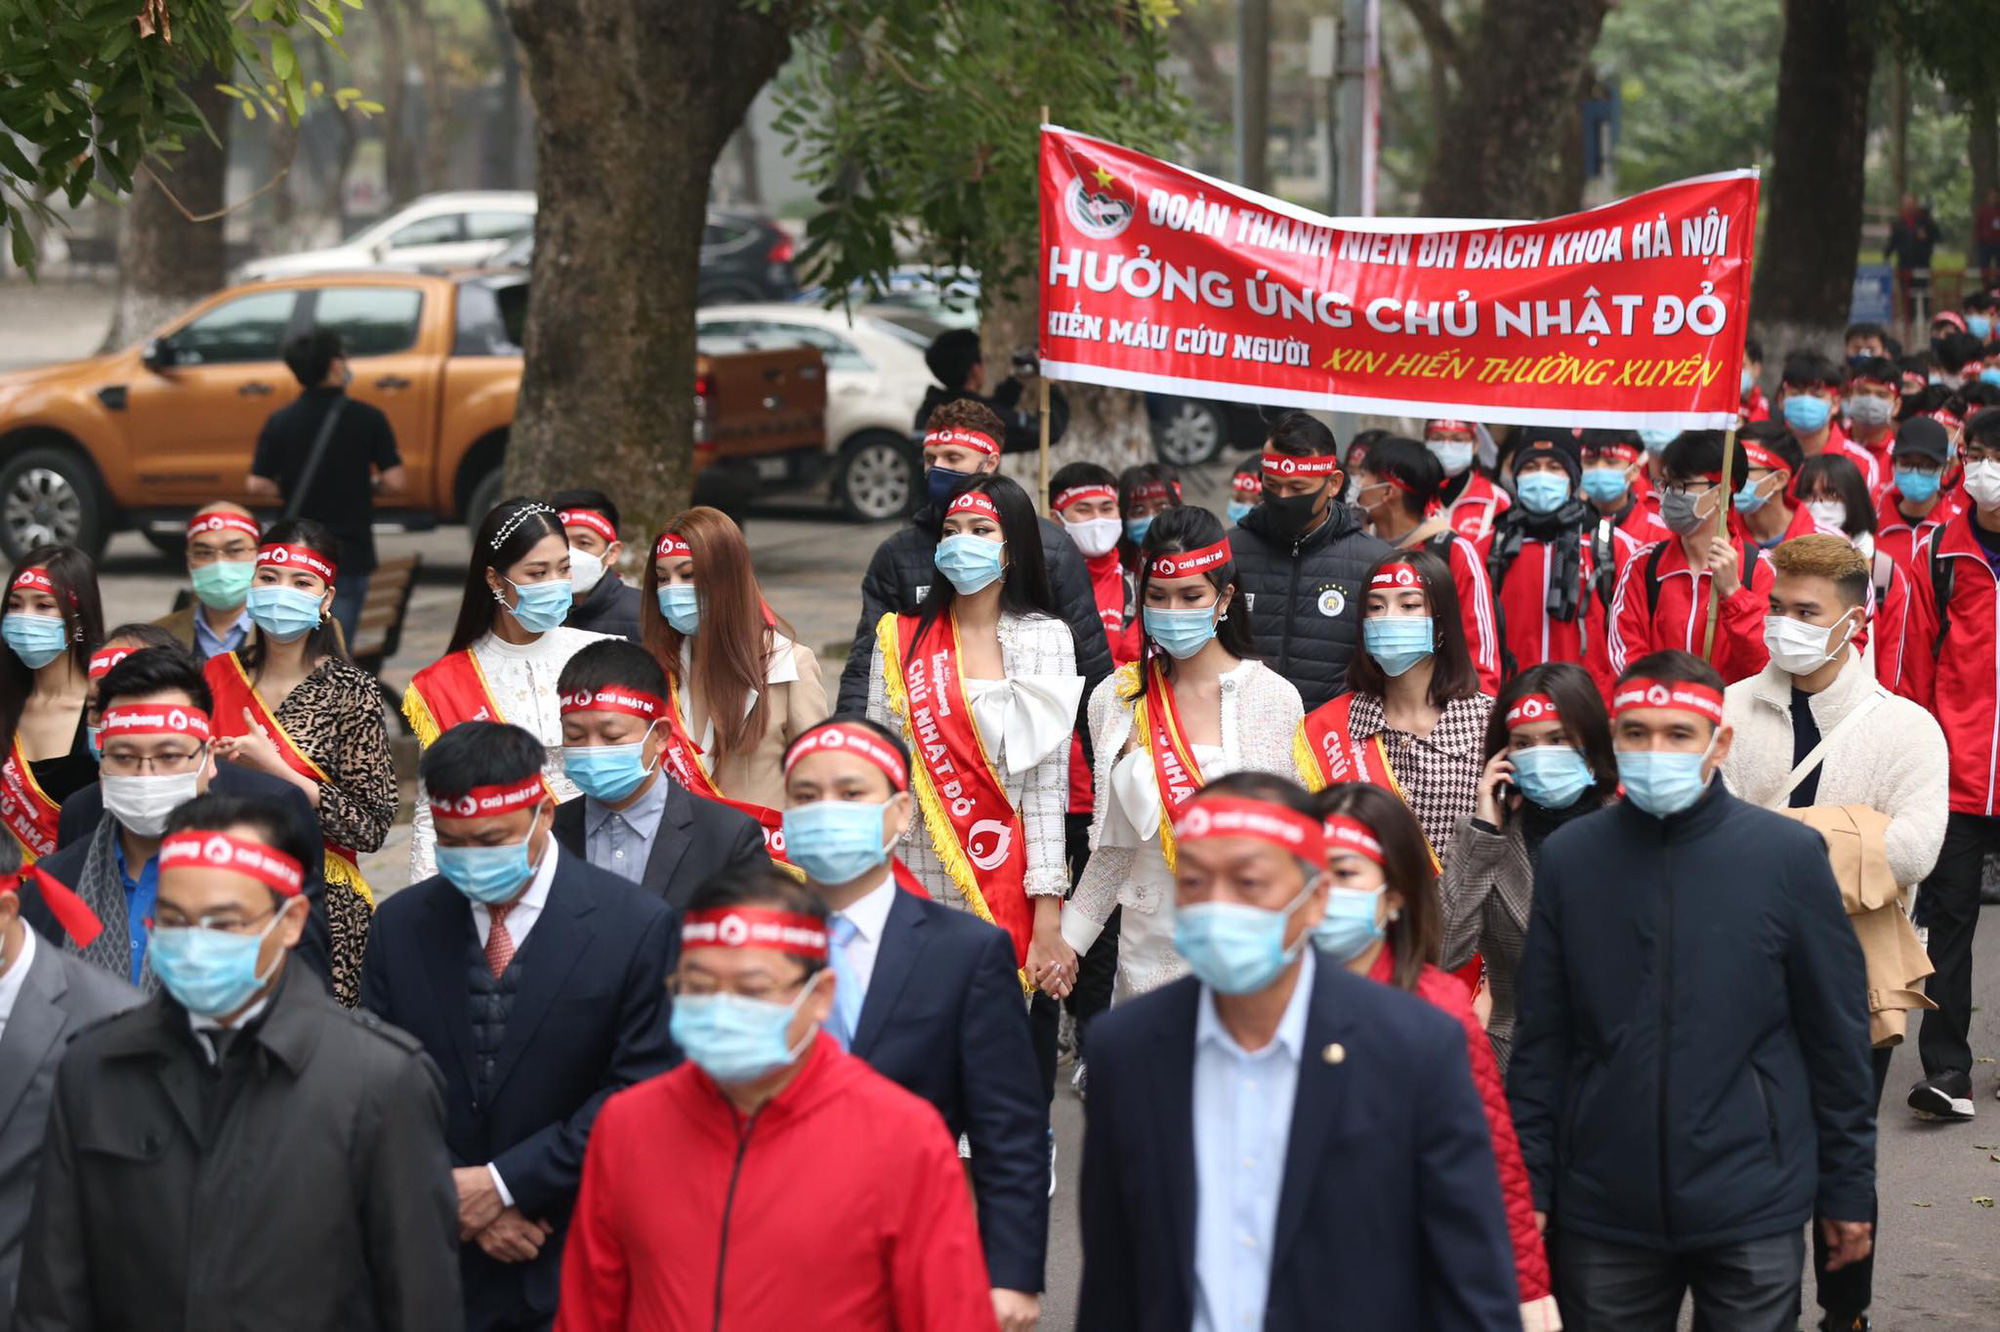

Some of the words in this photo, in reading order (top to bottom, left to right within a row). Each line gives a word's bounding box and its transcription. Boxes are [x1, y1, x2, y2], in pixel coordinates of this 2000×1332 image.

[1148, 188, 1231, 239] ĐOÀN
[1235, 209, 1334, 258] THANH
[1417, 233, 1460, 269] ĐH
[1463, 227, 1546, 270] BÁCH
[1547, 226, 1624, 267] KHOA
[1632, 212, 1673, 261] HÀ
[1681, 207, 1730, 266] NỘI
[1049, 244, 1235, 309] HƯỞNG
[1245, 269, 1354, 329] ỨNG
[1365, 289, 1479, 339] CHỦ
[1494, 284, 1644, 348] NHẬT
[1652, 281, 1728, 337] ĐỎ
[1107, 317, 1170, 350] MÁU
[1174, 323, 1228, 357] CỨU
[1232, 334, 1311, 367] NGƯỜI
[1321, 347, 1388, 374] XIN
[1384, 348, 1475, 380] HIẾN
[1477, 350, 1615, 386] THƯỜNG
[1612, 352, 1723, 387] XUYÊN
[908, 658, 932, 704] CHỦ
[913, 706, 955, 776] NHẬT
[1322, 730, 1352, 780] CHỦ
[942, 780, 977, 817] ĐỎ
[1162, 751, 1196, 806] NHẬ
[14, 814, 56, 858] NHẬ
